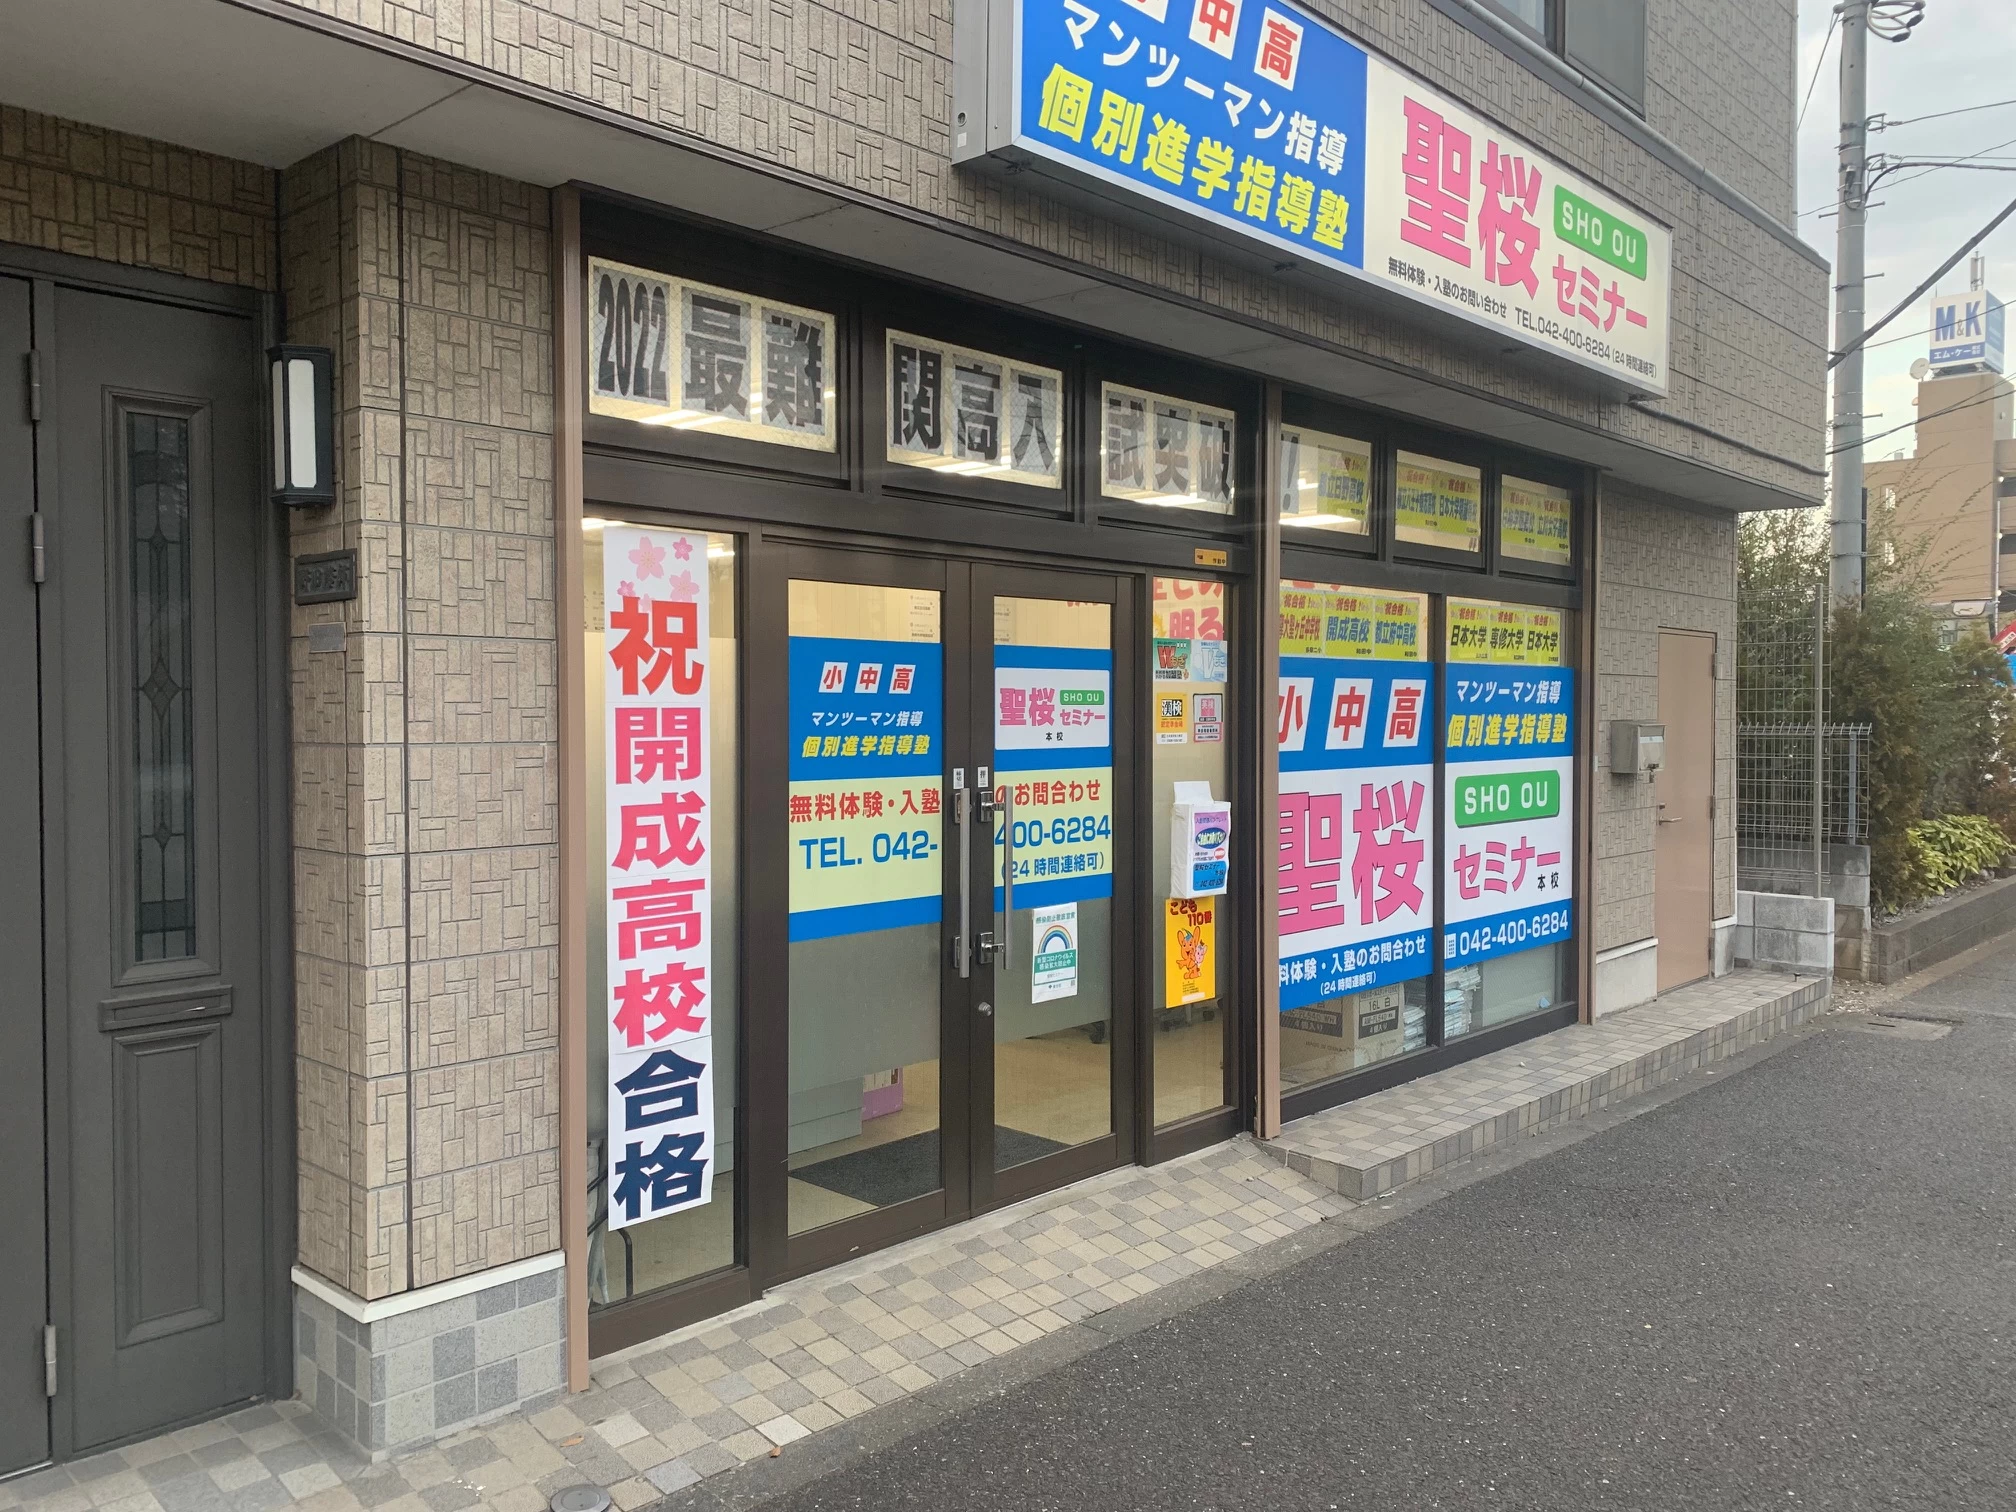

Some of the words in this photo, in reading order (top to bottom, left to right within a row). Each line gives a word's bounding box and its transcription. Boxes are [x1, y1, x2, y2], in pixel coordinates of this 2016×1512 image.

[1260, 19, 1298, 81] 高
[1063, 0, 1347, 176] マンツーマン指導
[1039, 63, 1350, 251] 個別進学指導塾
[1401, 96, 1542, 300] 聖桜
[1562, 202, 1602, 246] SHO
[1612, 227, 1636, 263] OU
[1388, 256, 1507, 319] 無料体験・入塾のお問い合わせ
[1552, 254, 1647, 333] セミナー
[1326, 616, 1371, 643] 開成高校
[1375, 620, 1417, 646] 都立府中高校
[1451, 624, 1487, 648] 日本大学
[1490, 627, 1524, 650] 専修大学
[1527, 630, 1558, 652] 日本大学
[822, 665, 843, 690] 小
[859, 666, 880, 690] 中
[892, 668, 913, 692] 高
[1456, 679, 1562, 705] マンツーマン指導
[1000, 687, 1055, 727] 聖桜
[1063, 692, 1082, 702] SHO
[1087, 692, 1100, 702] OU
[1161, 699, 1183, 717] 漢検
[811, 711, 924, 728] マンツーマン指導
[1060, 708, 1106, 727] セミナー
[1279, 685, 1304, 744] 小
[1333, 686, 1366, 742] 中
[1389, 687, 1422, 741] 高
[1046, 731, 1064, 742] 本校
[1447, 714, 1567, 748] 個別進学指導塾
[802, 735, 930, 758] 個別進学指導塾
[790, 788, 941, 823] 無料体験・入塾
[1464, 784, 1509, 815] SHO
[1521, 781, 1548, 810] OU
[800, 836, 863, 870] TEL.
[872, 830, 938, 864] 042-
[1279, 780, 1425, 936] 聖桜
[1454, 836, 1561, 900] セミナー
[1537, 872, 1559, 891] 本校
[1170, 900, 1197, 915] こども
[1187, 911, 1212, 927] 110番
[1459, 910, 1568, 956] 042-400-6284
[1037, 952, 1074, 965] 新型コロナウイルス
